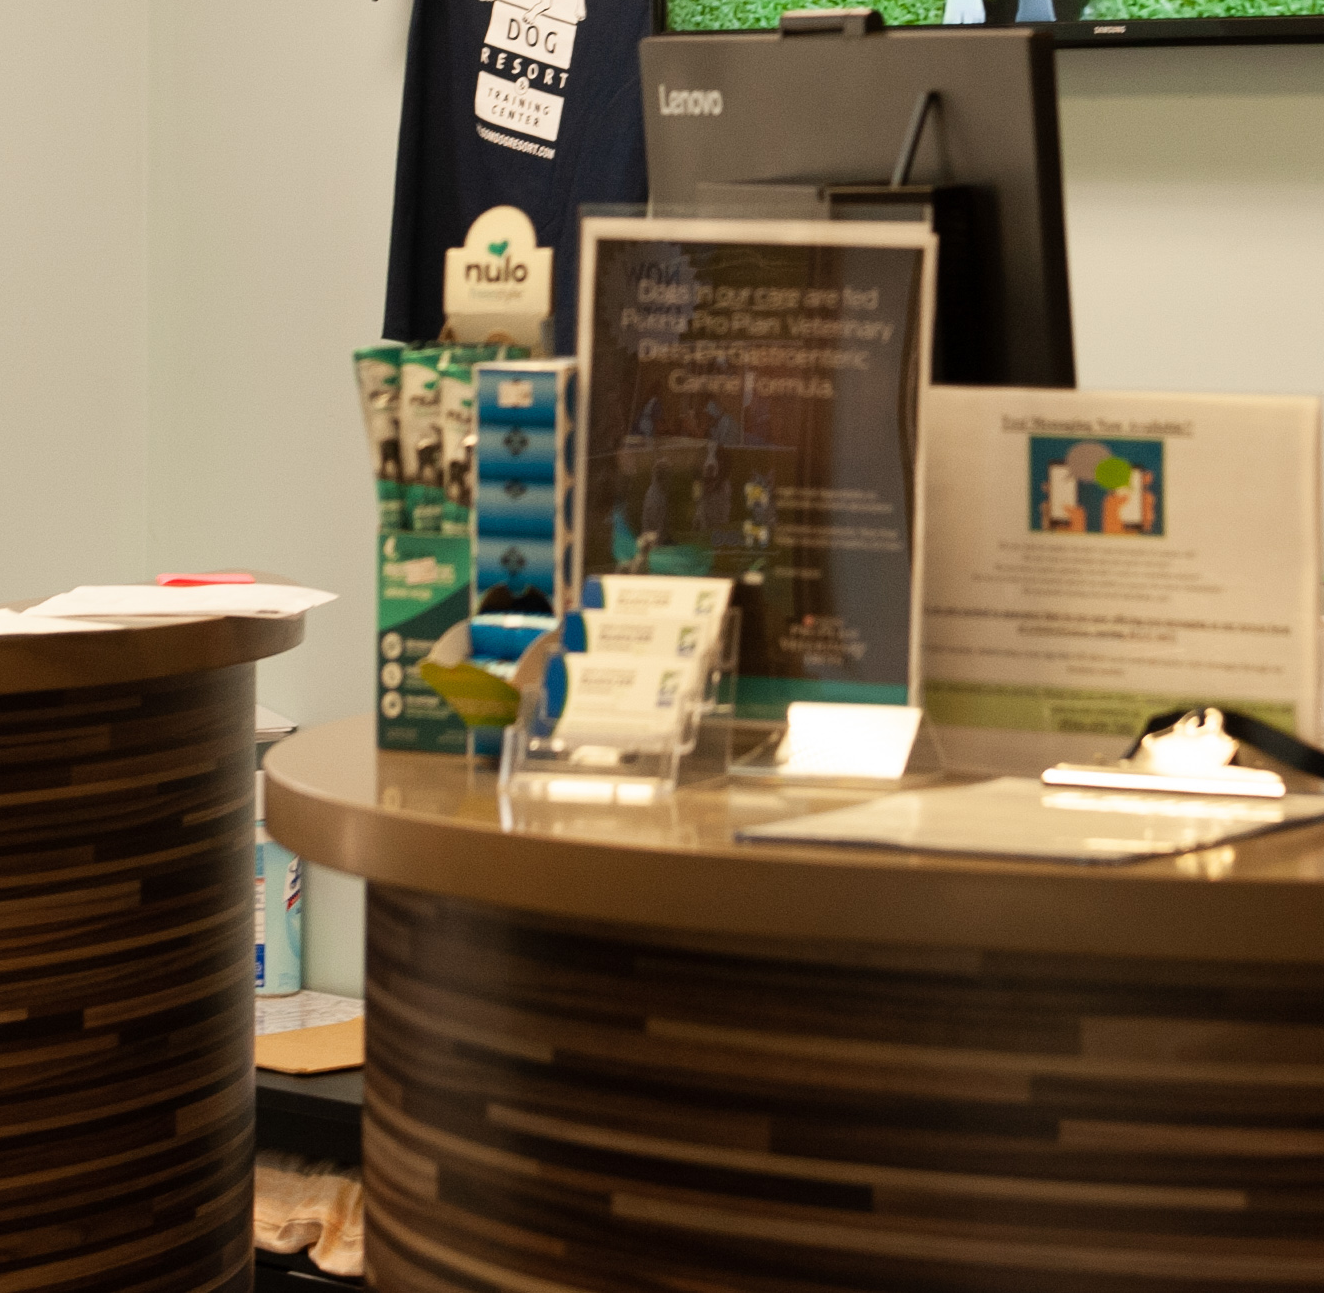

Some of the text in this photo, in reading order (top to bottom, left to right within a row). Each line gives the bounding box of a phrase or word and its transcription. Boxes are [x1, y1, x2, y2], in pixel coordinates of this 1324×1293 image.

[507, 18, 557, 54] DOG
[480, 46, 569, 89] RESORT
[487, 87, 551, 116] TRAINING
[658, 83, 724, 116] Lenovo
[491, 104, 540, 127] CENTER
[464, 257, 529, 283] nulo
